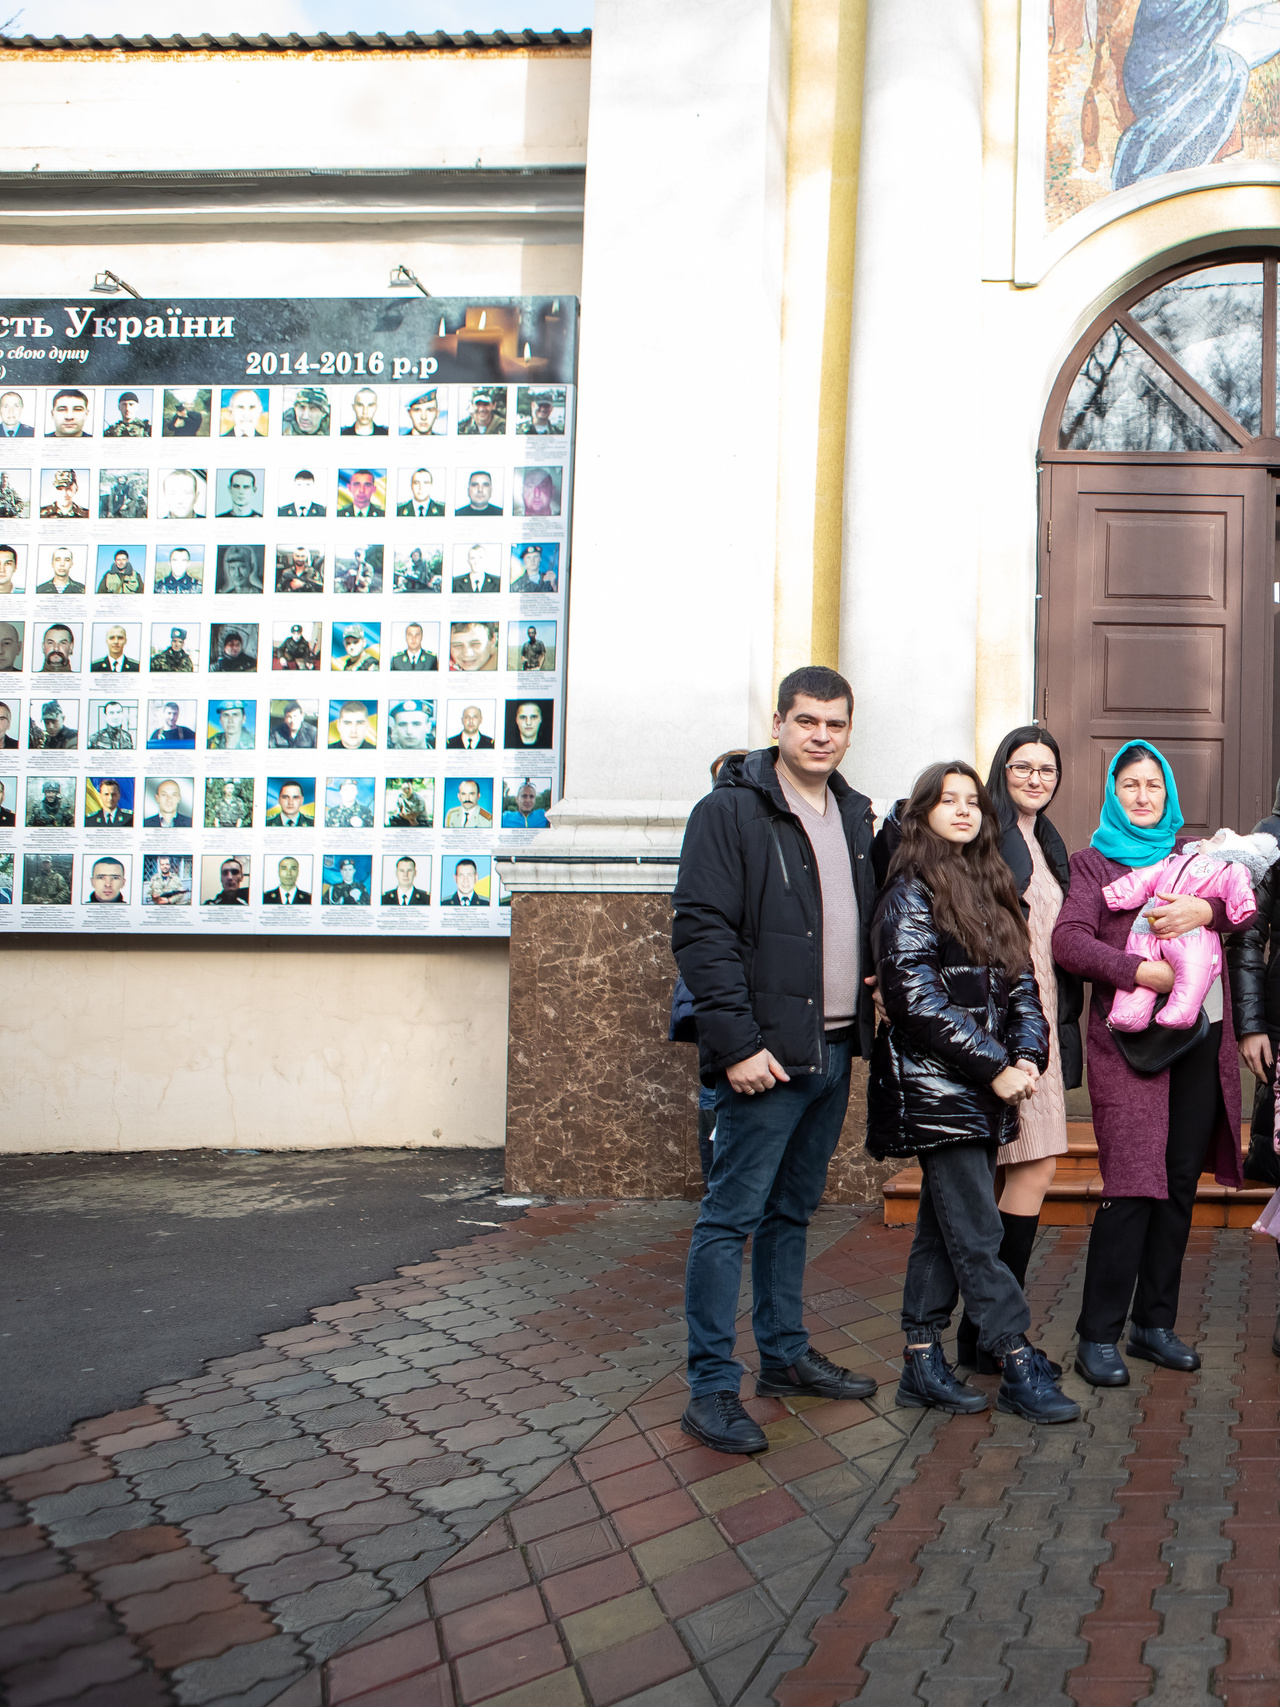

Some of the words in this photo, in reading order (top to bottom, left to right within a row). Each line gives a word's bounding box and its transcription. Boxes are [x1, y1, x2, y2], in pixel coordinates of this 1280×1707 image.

[64, 307, 235, 345] України
[7, 345, 46, 360] свою
[48, 345, 90, 364] душу
[246, 351, 385, 375] 2014-2016
